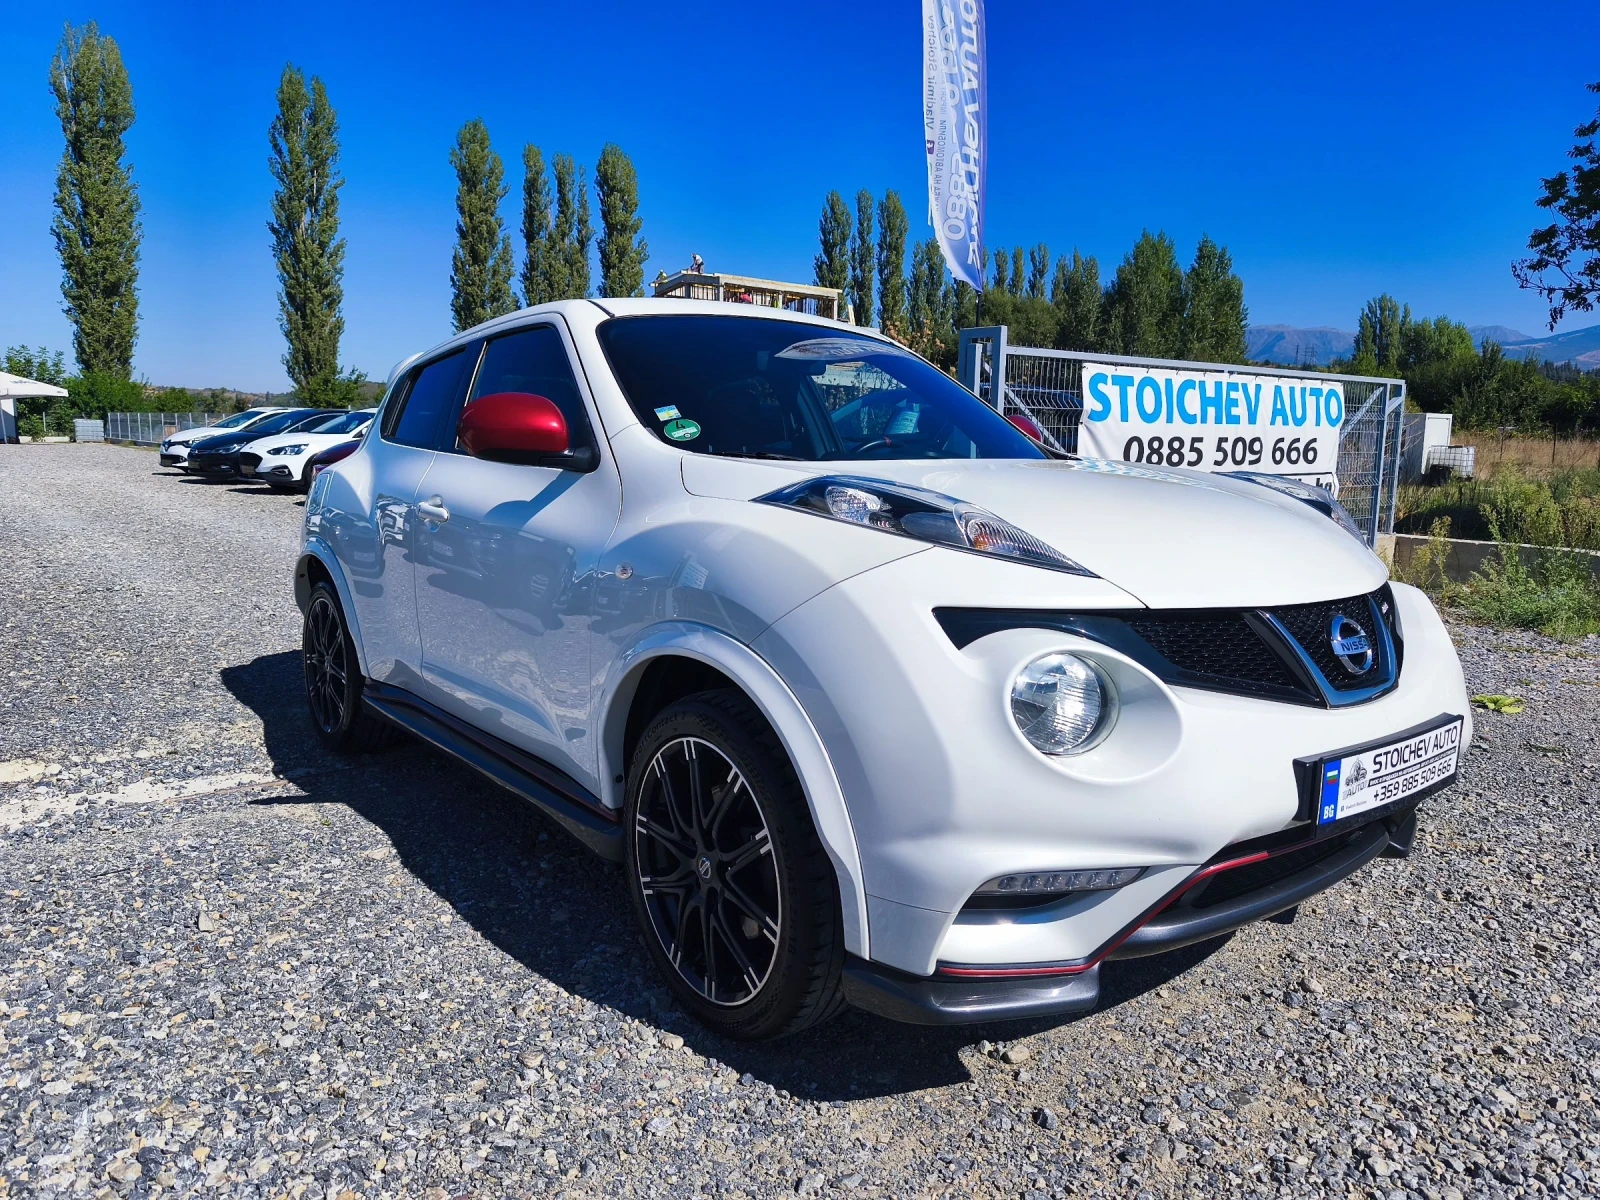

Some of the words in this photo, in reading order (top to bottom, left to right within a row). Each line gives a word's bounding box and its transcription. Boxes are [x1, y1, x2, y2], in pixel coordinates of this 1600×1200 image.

[1087, 371, 1262, 426] STOICHEV
[1270, 384, 1343, 428] AUTO
[1123, 435, 1205, 468] 0885
[1213, 435, 1263, 467] 509
[1271, 436, 1318, 466] 666
[1373, 736, 1431, 773] STOICHEV
[1432, 725, 1458, 752] AUTO
[1373, 780, 1400, 801] +359
[1400, 772, 1419, 793] 885
[1420, 765, 1437, 785] 509
[1437, 758, 1452, 777] 666
[1323, 804, 1335, 820] BG
